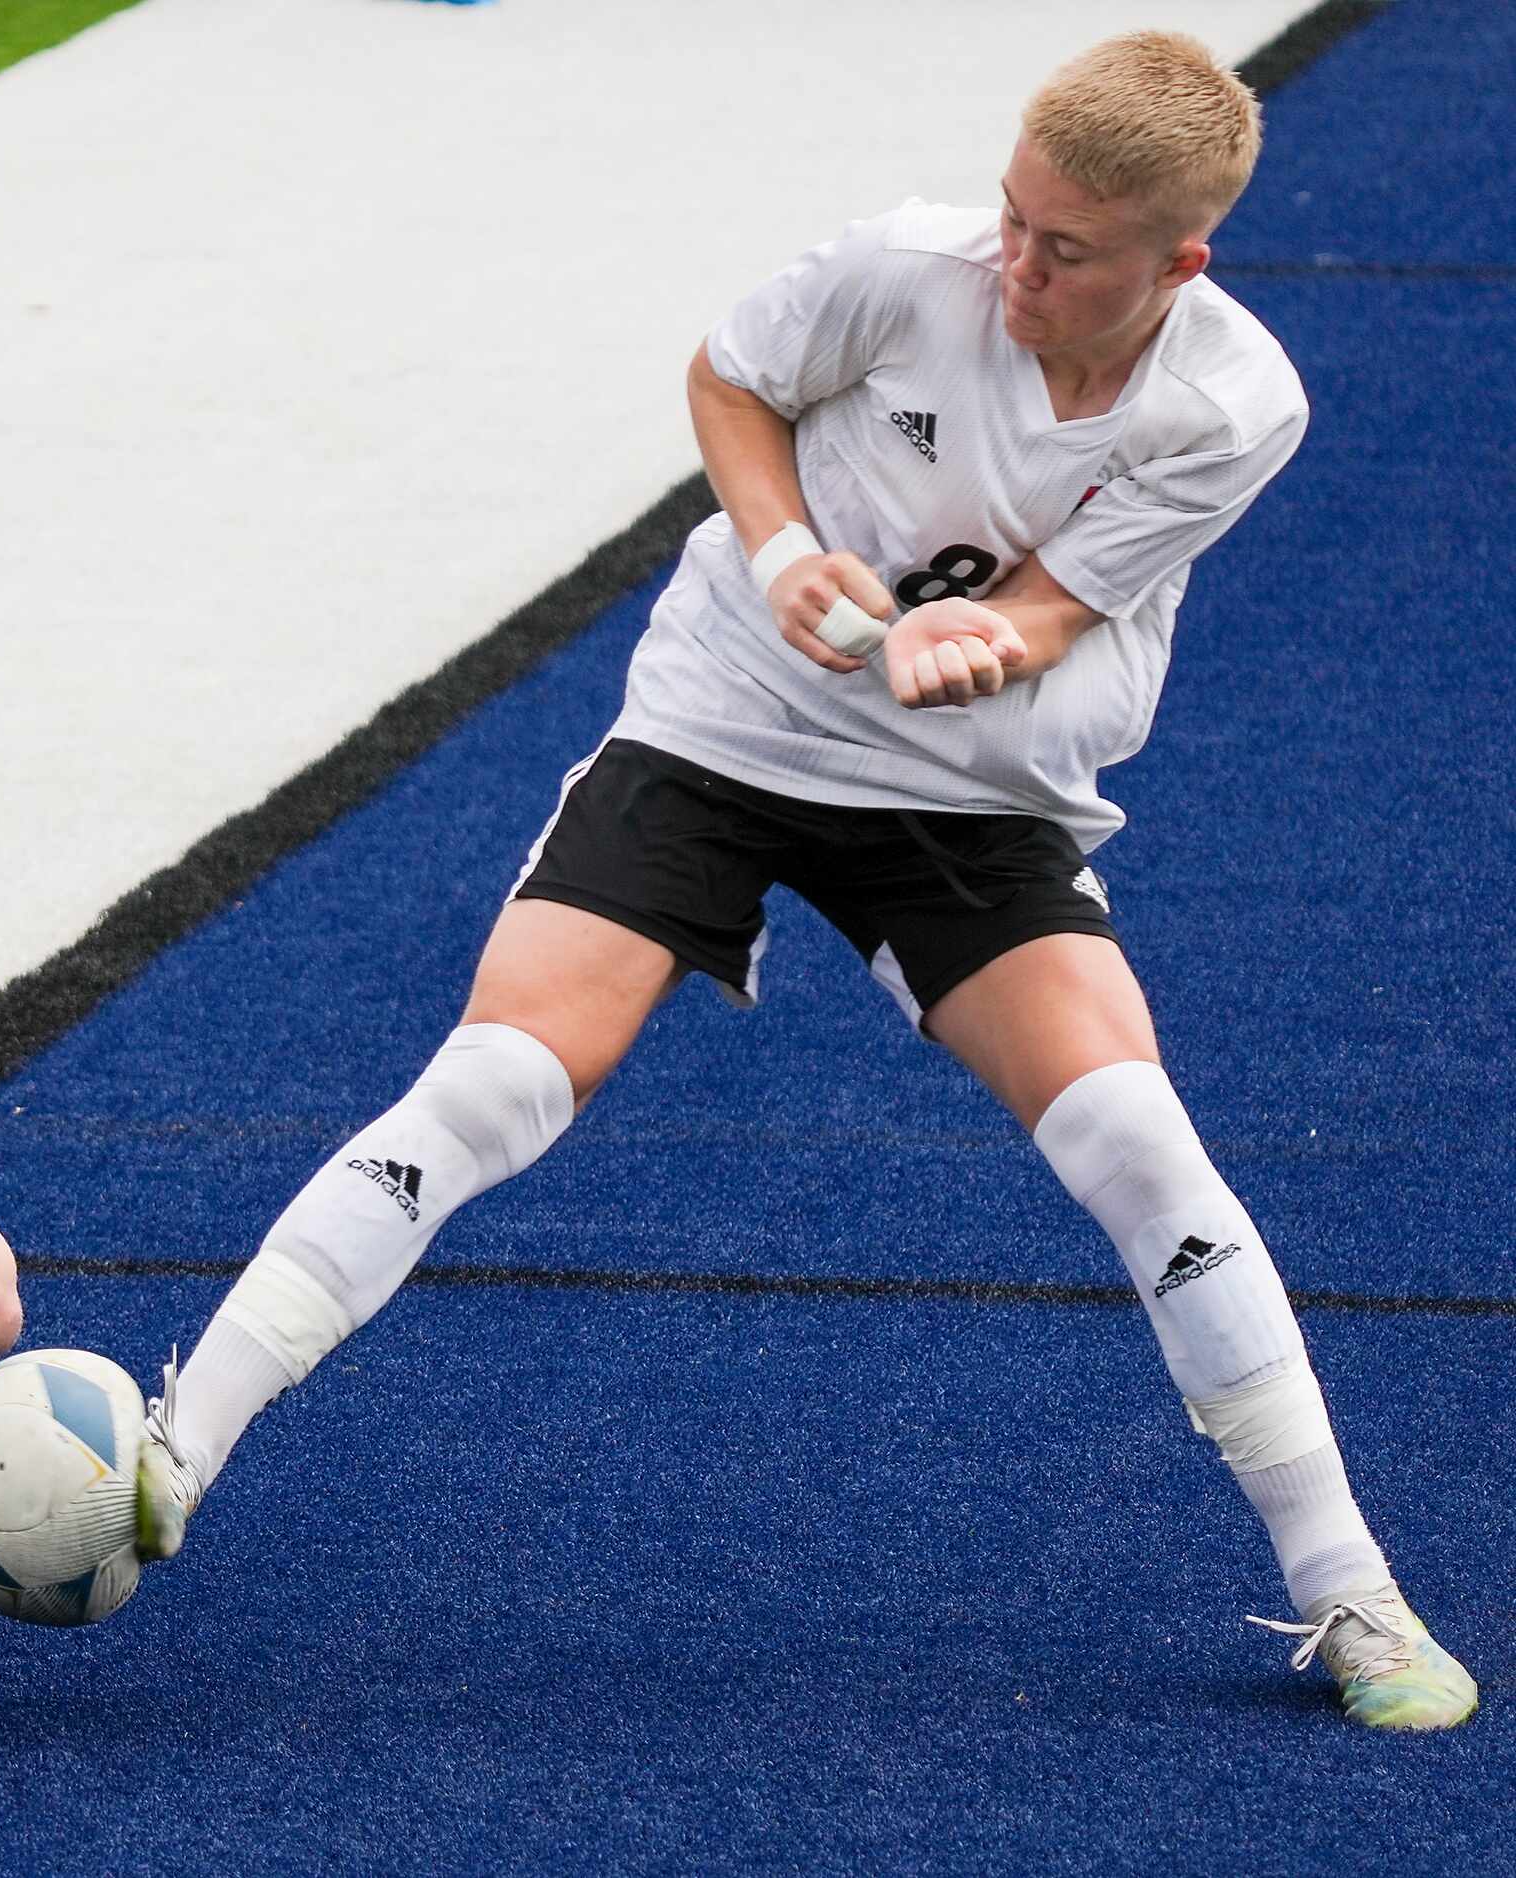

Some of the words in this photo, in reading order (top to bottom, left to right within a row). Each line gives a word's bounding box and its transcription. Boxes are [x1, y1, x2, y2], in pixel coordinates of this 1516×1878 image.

[891, 412, 938, 463] adidas
[896, 543, 999, 607] 8
[347, 1158, 420, 1222] adidas
